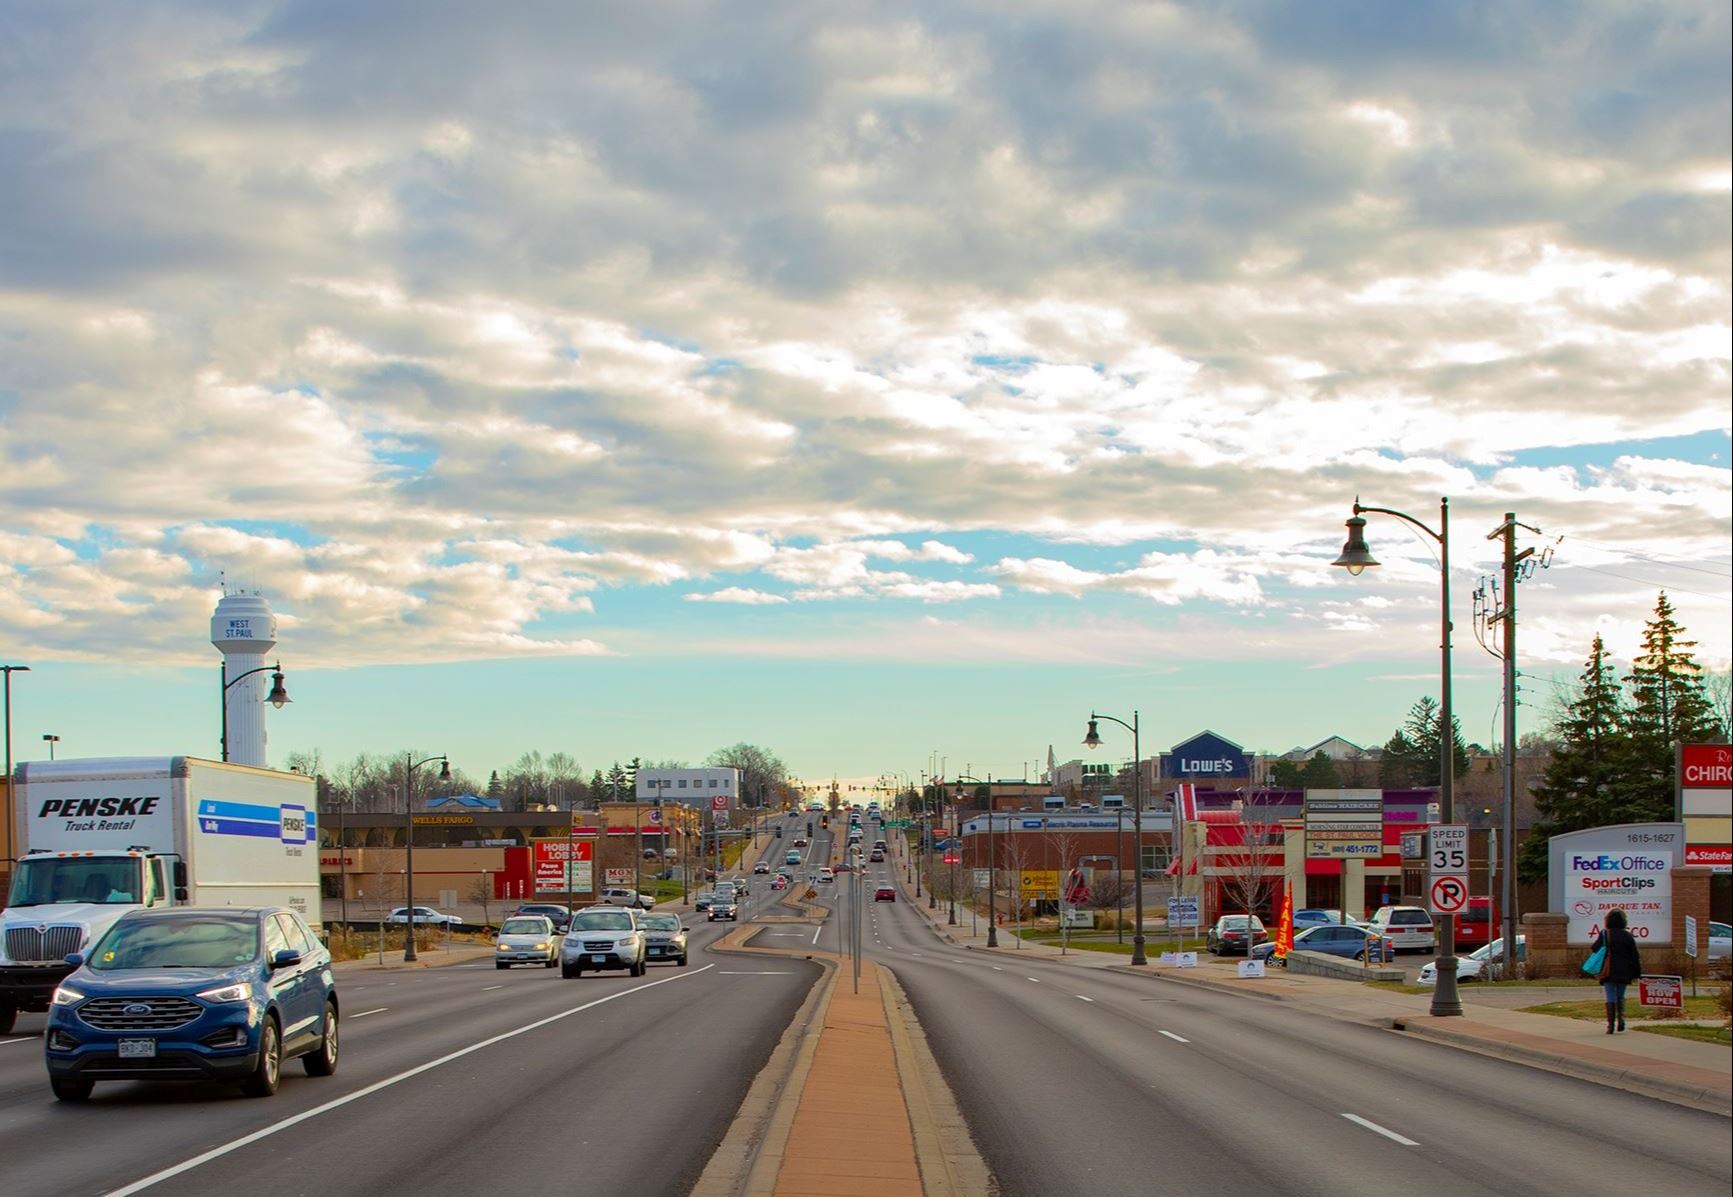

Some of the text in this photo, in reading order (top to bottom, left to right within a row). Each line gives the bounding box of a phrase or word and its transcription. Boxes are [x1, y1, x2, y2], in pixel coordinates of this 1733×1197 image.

[229, 620, 249, 628] WEST
[38, 797, 160, 818] PENSKE
[283, 817, 304, 831] PENSKE
[413, 816, 473, 824] WELLS FARGO
[65, 820, 136, 831] Truck Rental
[1432, 830, 1465, 839] SPEED
[1627, 833, 1675, 843] 1615-1627
[543, 843, 580, 852] HOBBY
[1345, 845, 1378, 853] 451-1772
[1436, 841, 1461, 849] LIMIT
[548, 851, 583, 860] LOBBY
[1434, 851, 1464, 868] 35
[1646, 996, 1677, 1005] OPEN
